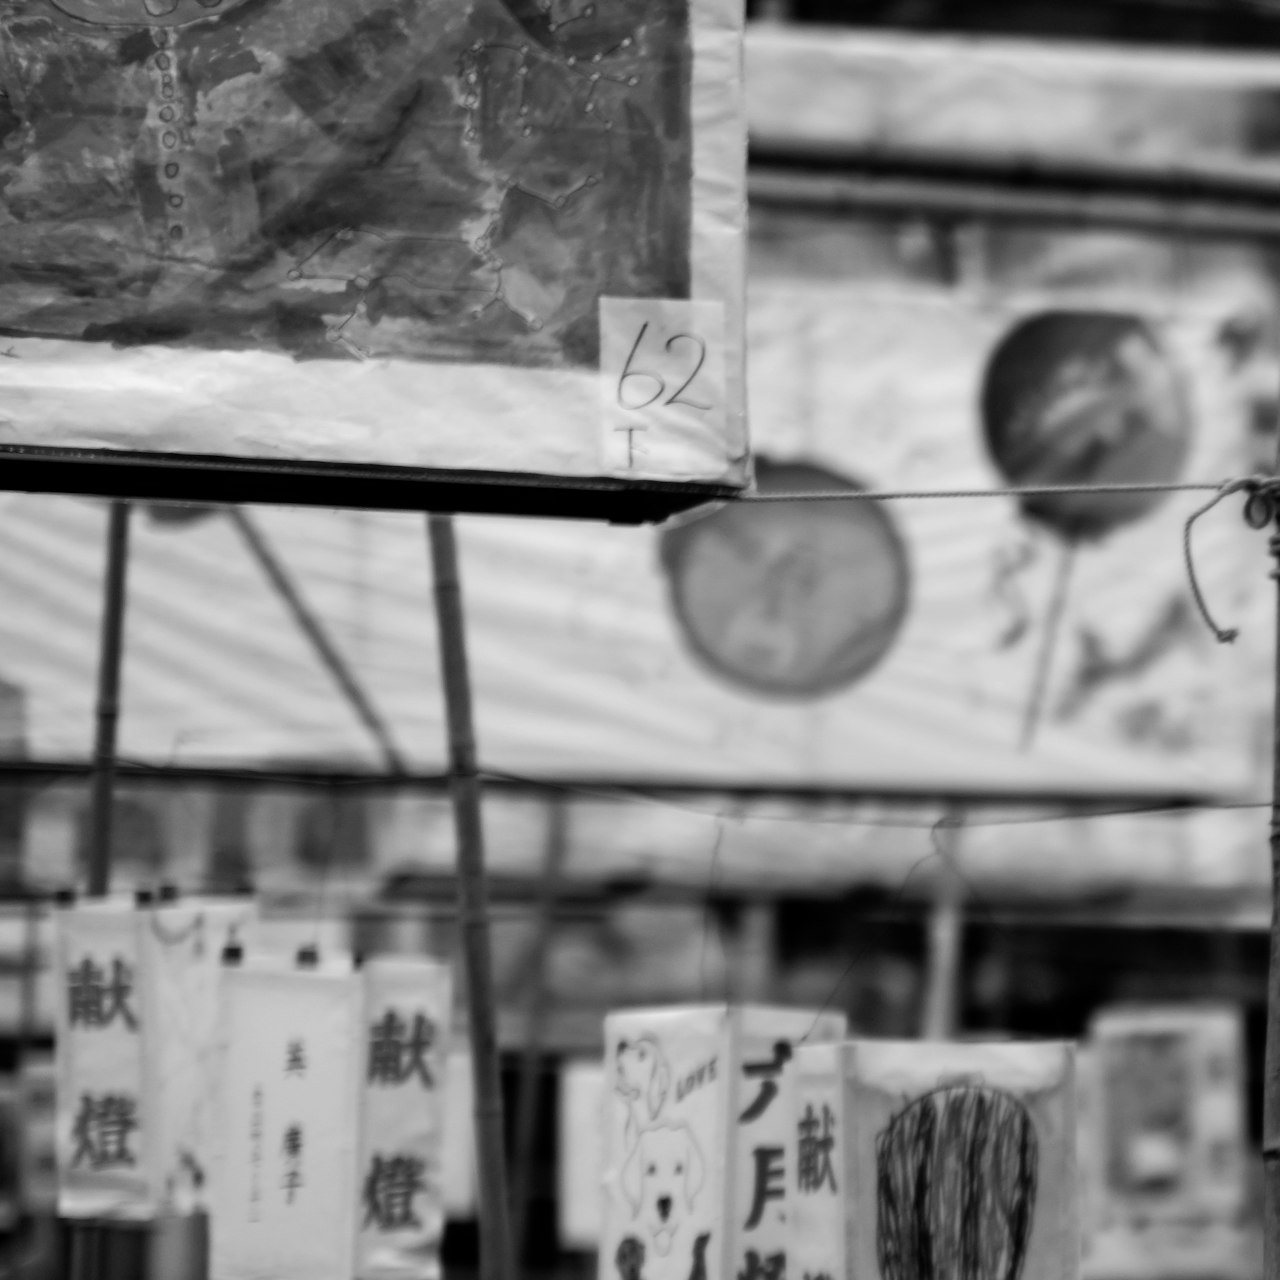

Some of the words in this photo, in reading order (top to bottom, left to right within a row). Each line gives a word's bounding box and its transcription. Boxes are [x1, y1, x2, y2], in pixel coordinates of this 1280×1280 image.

[618, 321, 714, 412] 62
[66, 956, 141, 1172] 献燈
[361, 1009, 437, 1236] 献燈
